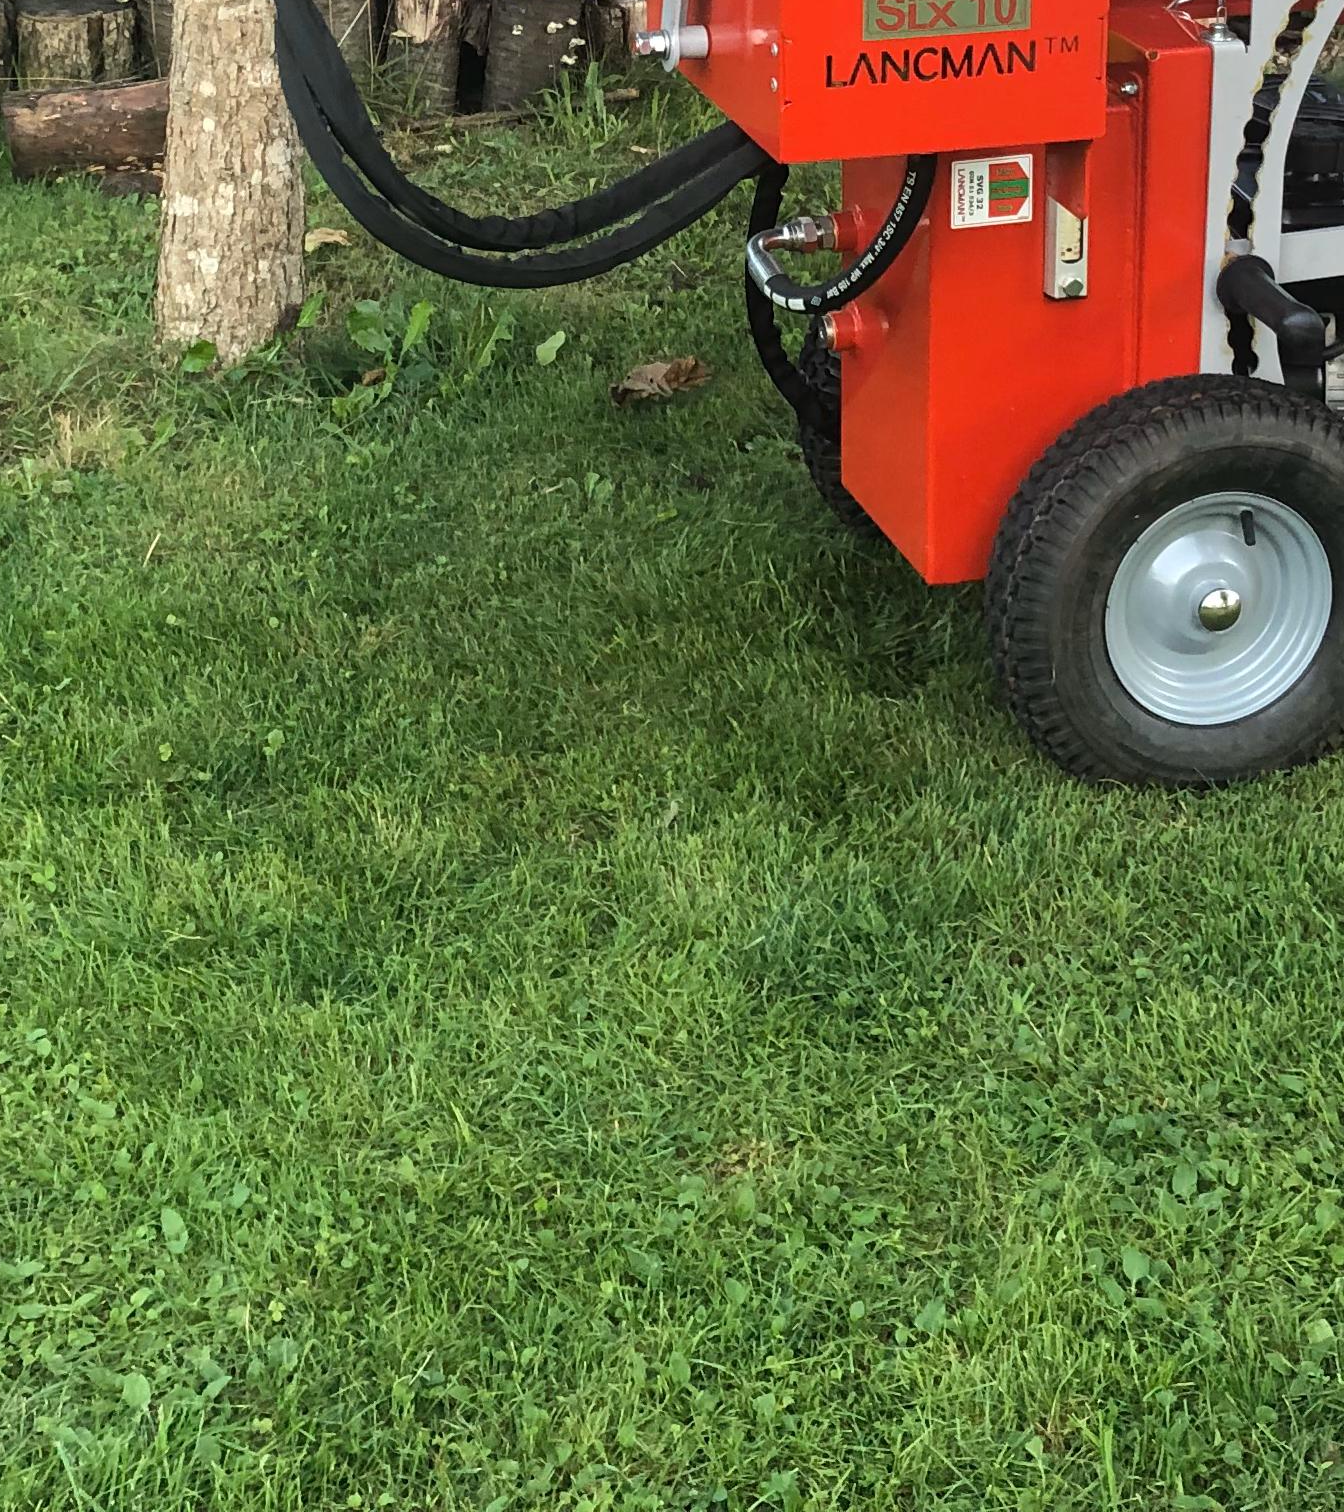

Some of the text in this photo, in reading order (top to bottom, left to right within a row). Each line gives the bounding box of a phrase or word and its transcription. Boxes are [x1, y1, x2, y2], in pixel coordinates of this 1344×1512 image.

[825, 40, 1037, 88] LANCMAN
[906, 172, 916, 186] TS
[900, 186, 912, 203] EN
[893, 202, 905, 222] 857
[976, 197, 984, 210] 32
